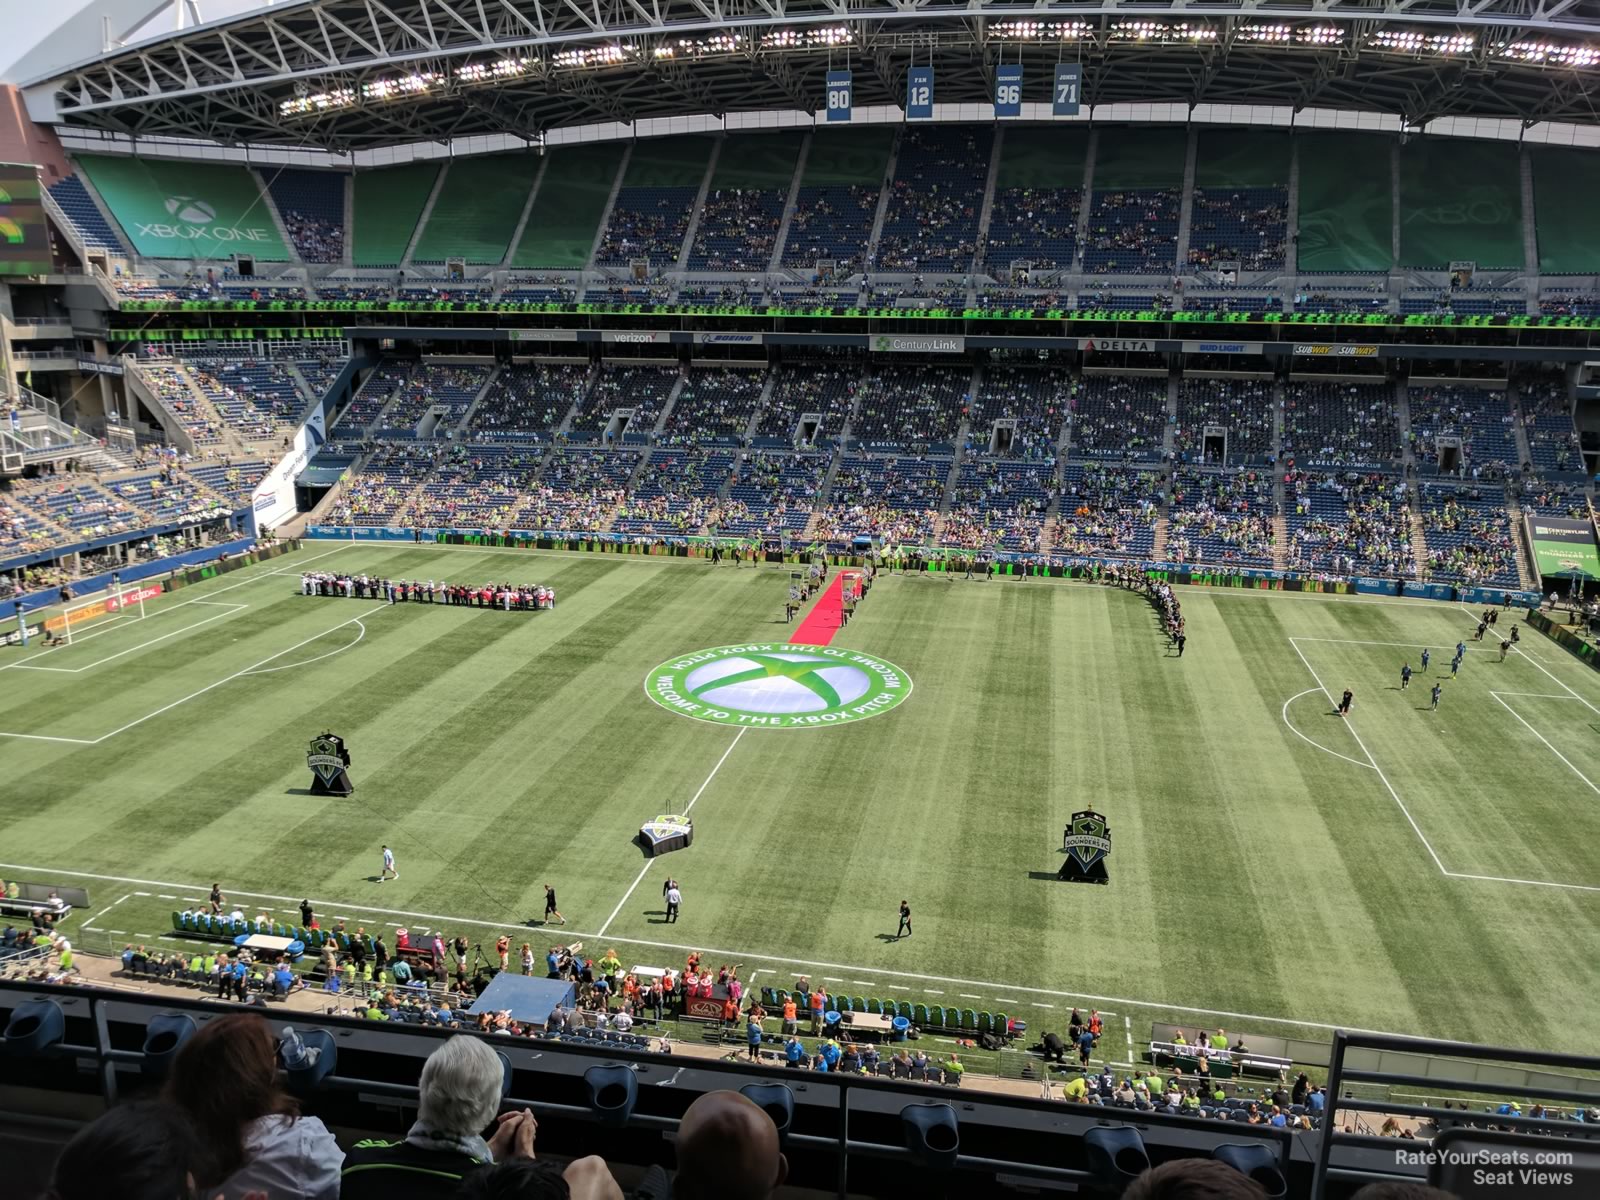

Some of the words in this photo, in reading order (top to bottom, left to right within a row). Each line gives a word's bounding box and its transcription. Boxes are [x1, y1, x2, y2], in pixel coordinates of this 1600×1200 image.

[828, 90, 850, 109] 80
[911, 87, 929, 106] 12
[997, 85, 1020, 104] 96
[1057, 84, 1076, 104] 71
[134, 222, 213, 240] XBOX
[212, 226, 272, 242] ONE
[614, 332, 653, 343] verizon
[893, 339, 957, 351] CenturyLink
[1100, 341, 1148, 351] DELTA
[1200, 344, 1218, 352] BUD
[1219, 344, 1244, 352] LIGHT
[1295, 345, 1333, 354] SUBWAY
[1338, 346, 1377, 355] SUBWAY
[719, 645, 773, 655] XBOX
[779, 645, 817, 653] THE
[823, 649, 848, 658] TO
[669, 653, 717, 670] PITCH
[849, 655, 901, 689] WELCOME
[656, 675, 702, 712] WELCOME
[703, 708, 730, 719] TO
[738, 714, 781, 725] THE
[790, 710, 854, 724] XBOX
[851, 692, 897, 715] PITCH
[1066, 839, 1100, 847] SOUNDERS
[1101, 842, 1109, 851] FC
